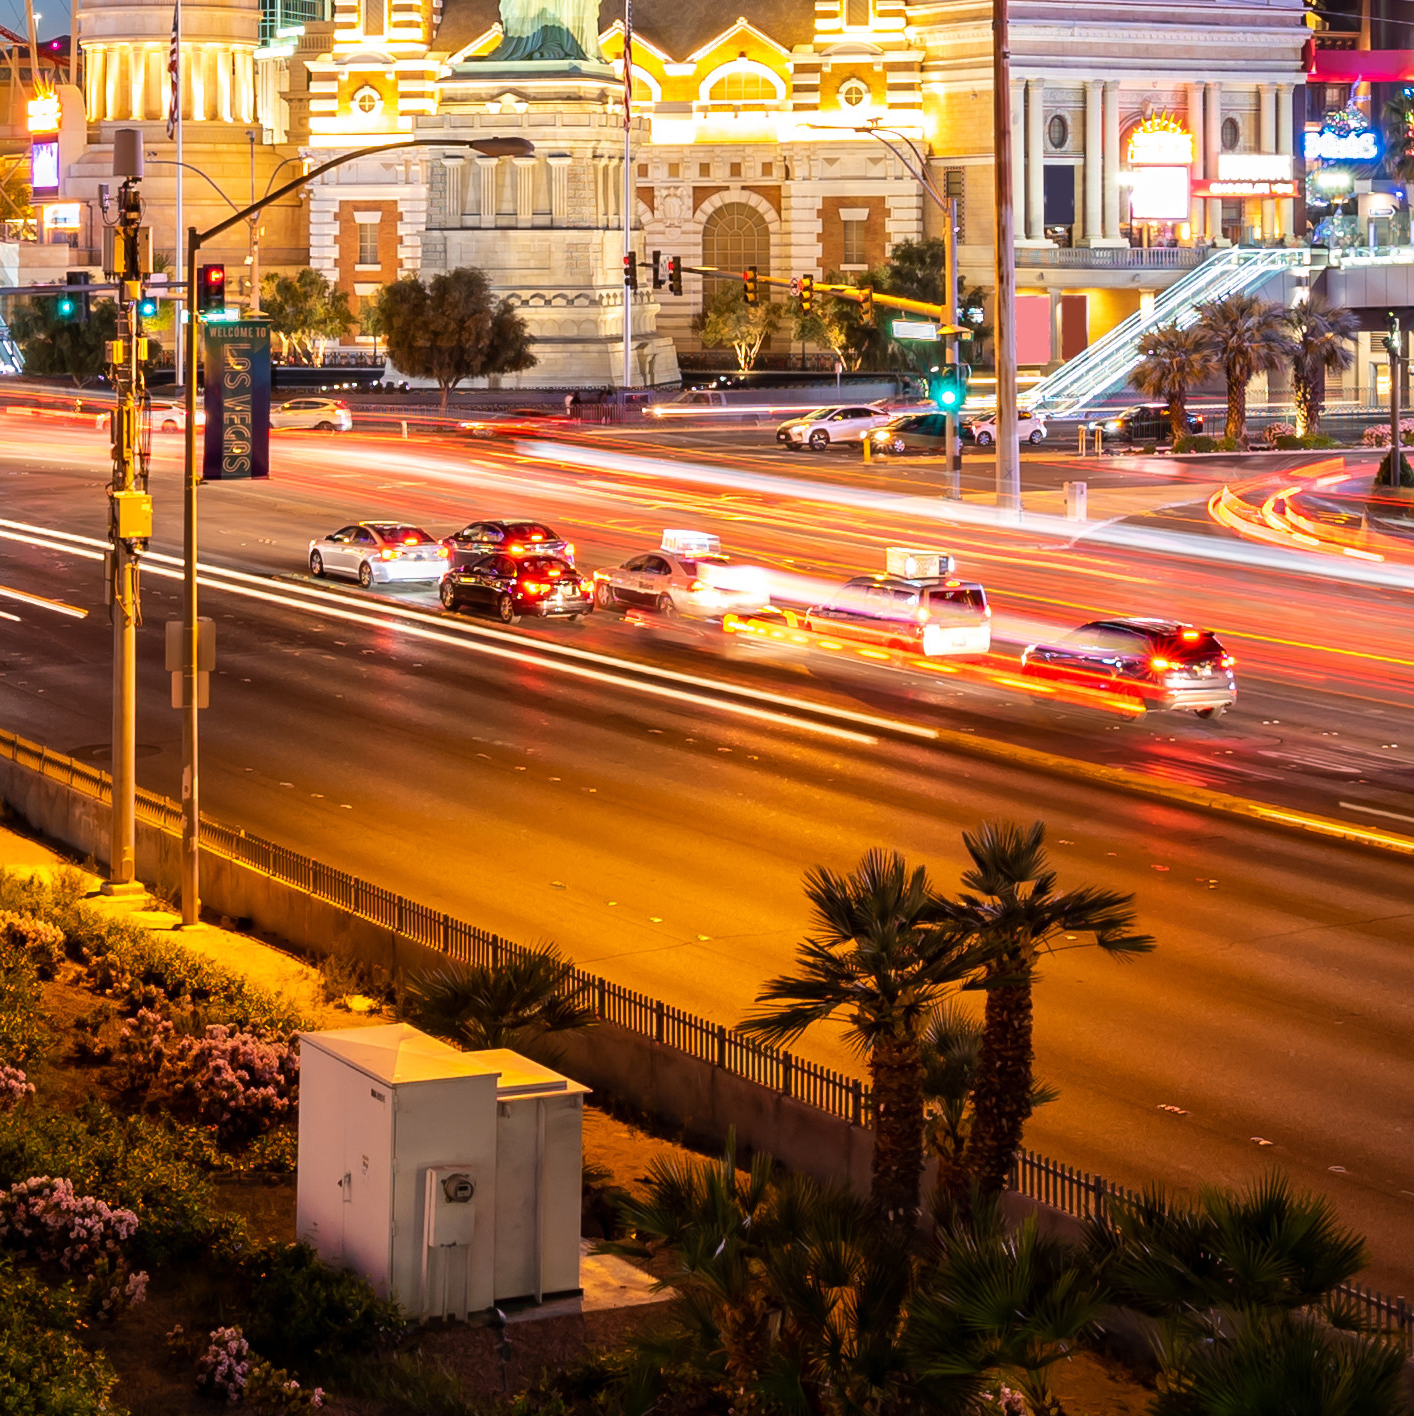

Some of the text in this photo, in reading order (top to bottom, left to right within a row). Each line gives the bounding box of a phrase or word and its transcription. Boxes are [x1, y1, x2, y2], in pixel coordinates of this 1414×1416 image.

[209, 327, 267, 338] WELCOME TO
[222, 343, 252, 473] LAS VEGAS
